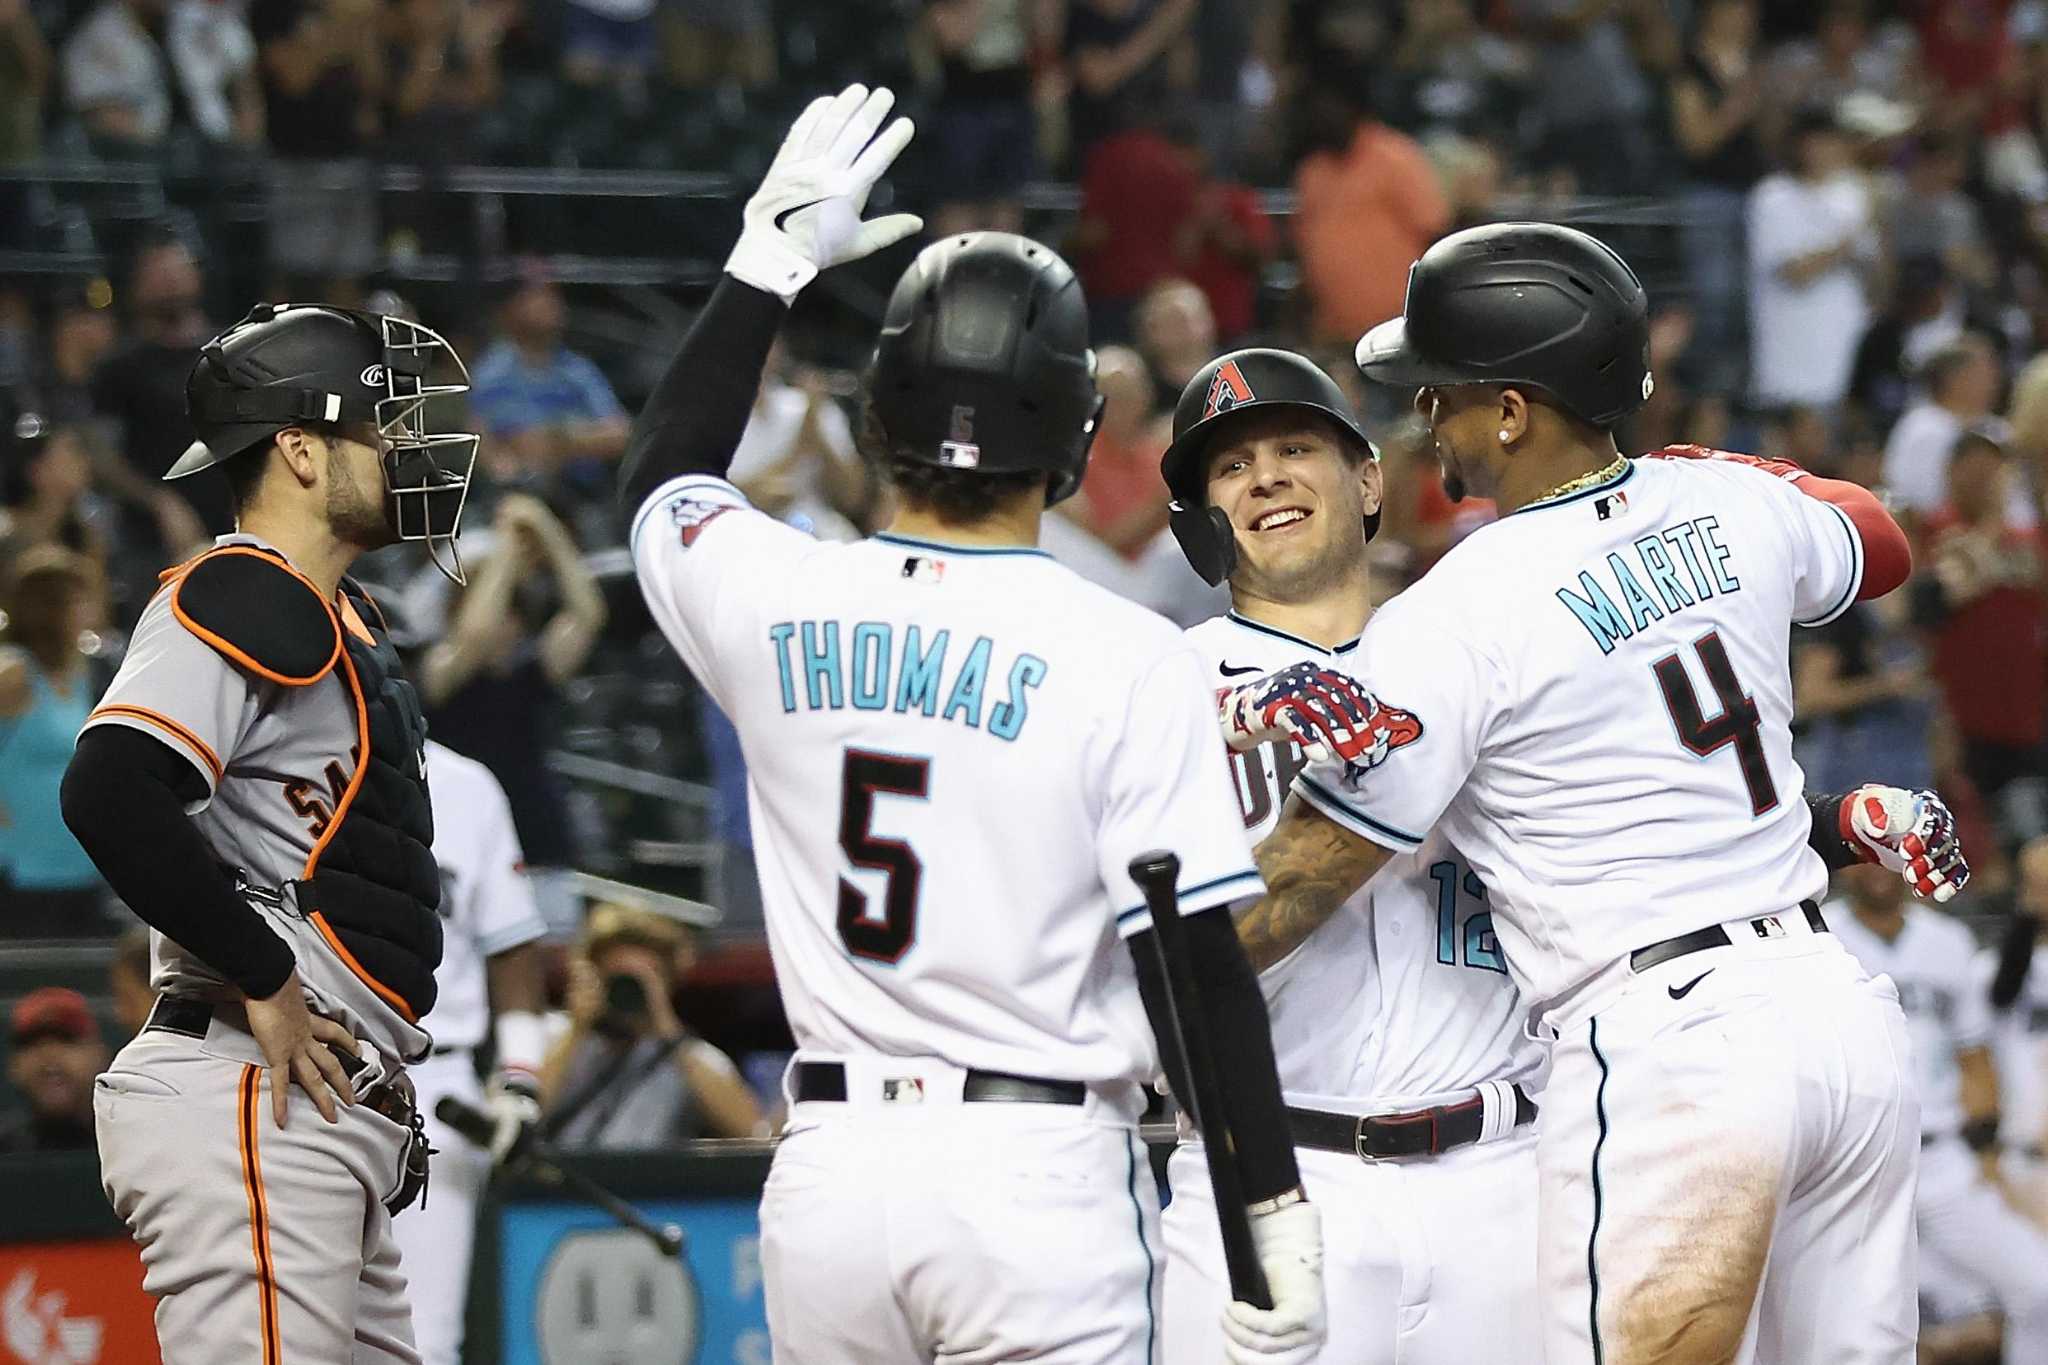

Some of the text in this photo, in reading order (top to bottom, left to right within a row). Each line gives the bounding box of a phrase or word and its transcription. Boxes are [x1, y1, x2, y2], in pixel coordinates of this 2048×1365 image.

[1555, 514, 1741, 656] MARTE
[769, 620, 1049, 742] THOMAS
[1650, 628, 1780, 819] 4
[283, 743, 360, 841] SA
[836, 745, 931, 967] 5
[1430, 861, 1509, 975] 12
